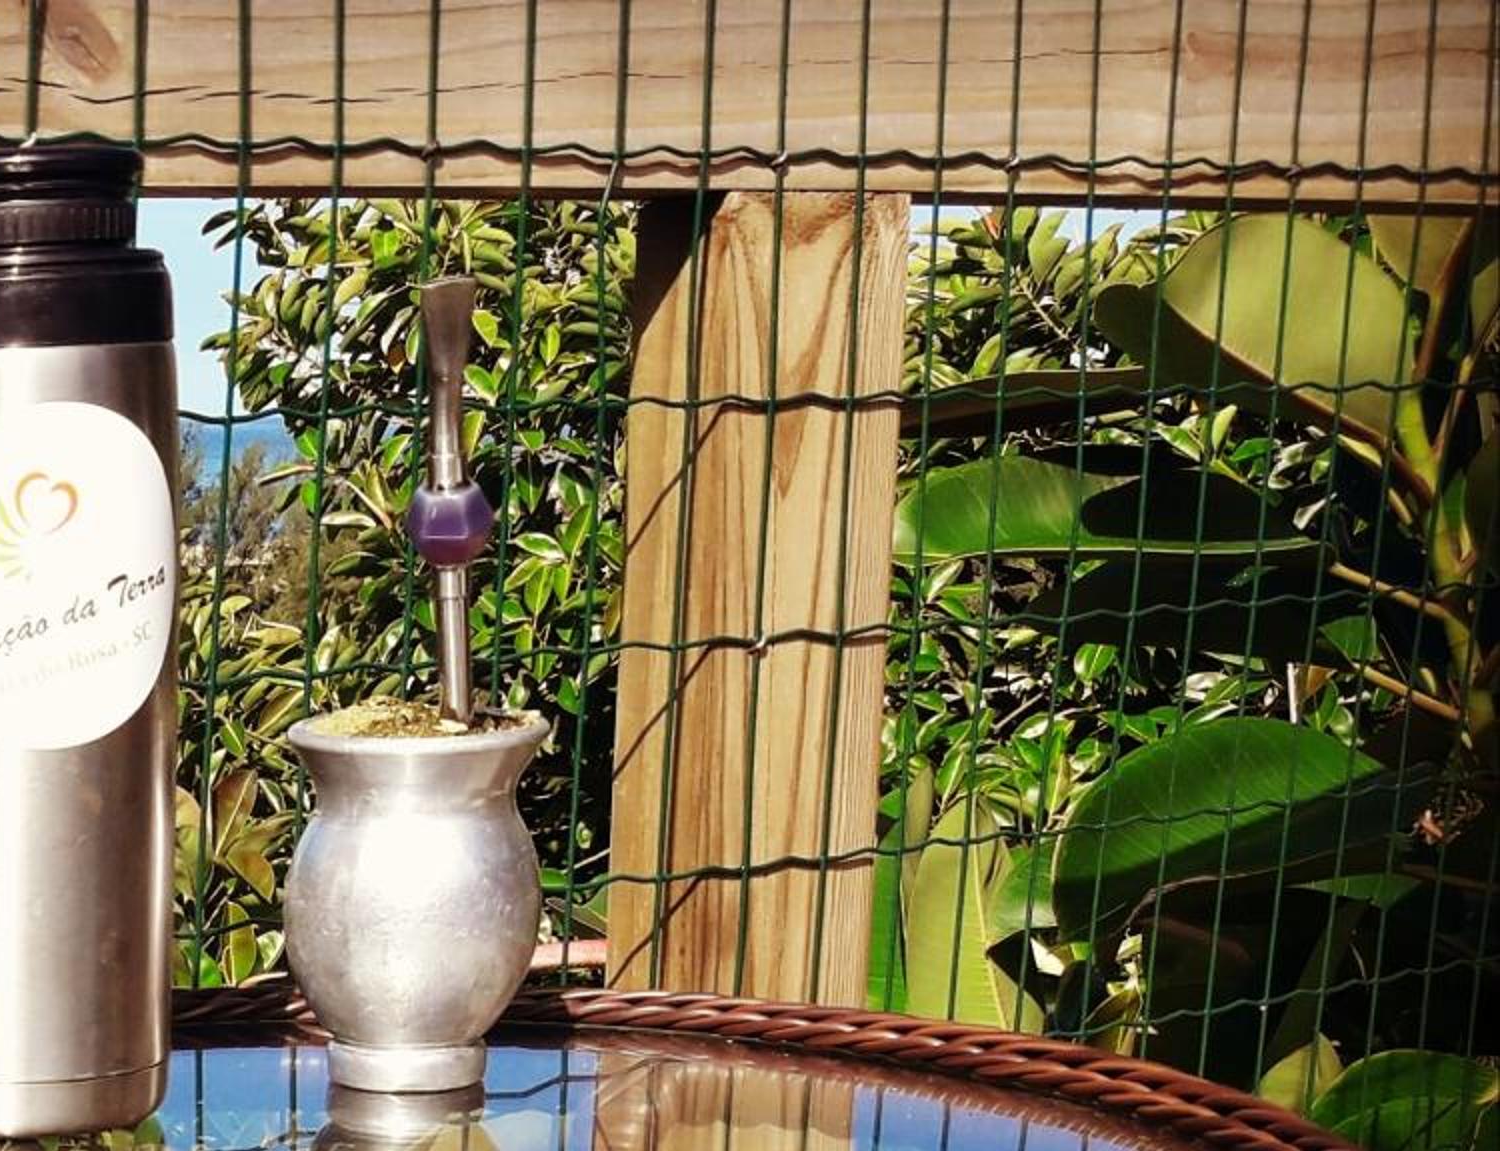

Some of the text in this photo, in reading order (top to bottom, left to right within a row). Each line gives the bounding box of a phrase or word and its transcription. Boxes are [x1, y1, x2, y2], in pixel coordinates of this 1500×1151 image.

[62, 594, 99, 626] da
[106, 563, 167, 609] Terra
[131, 619, 154, 648] SC
